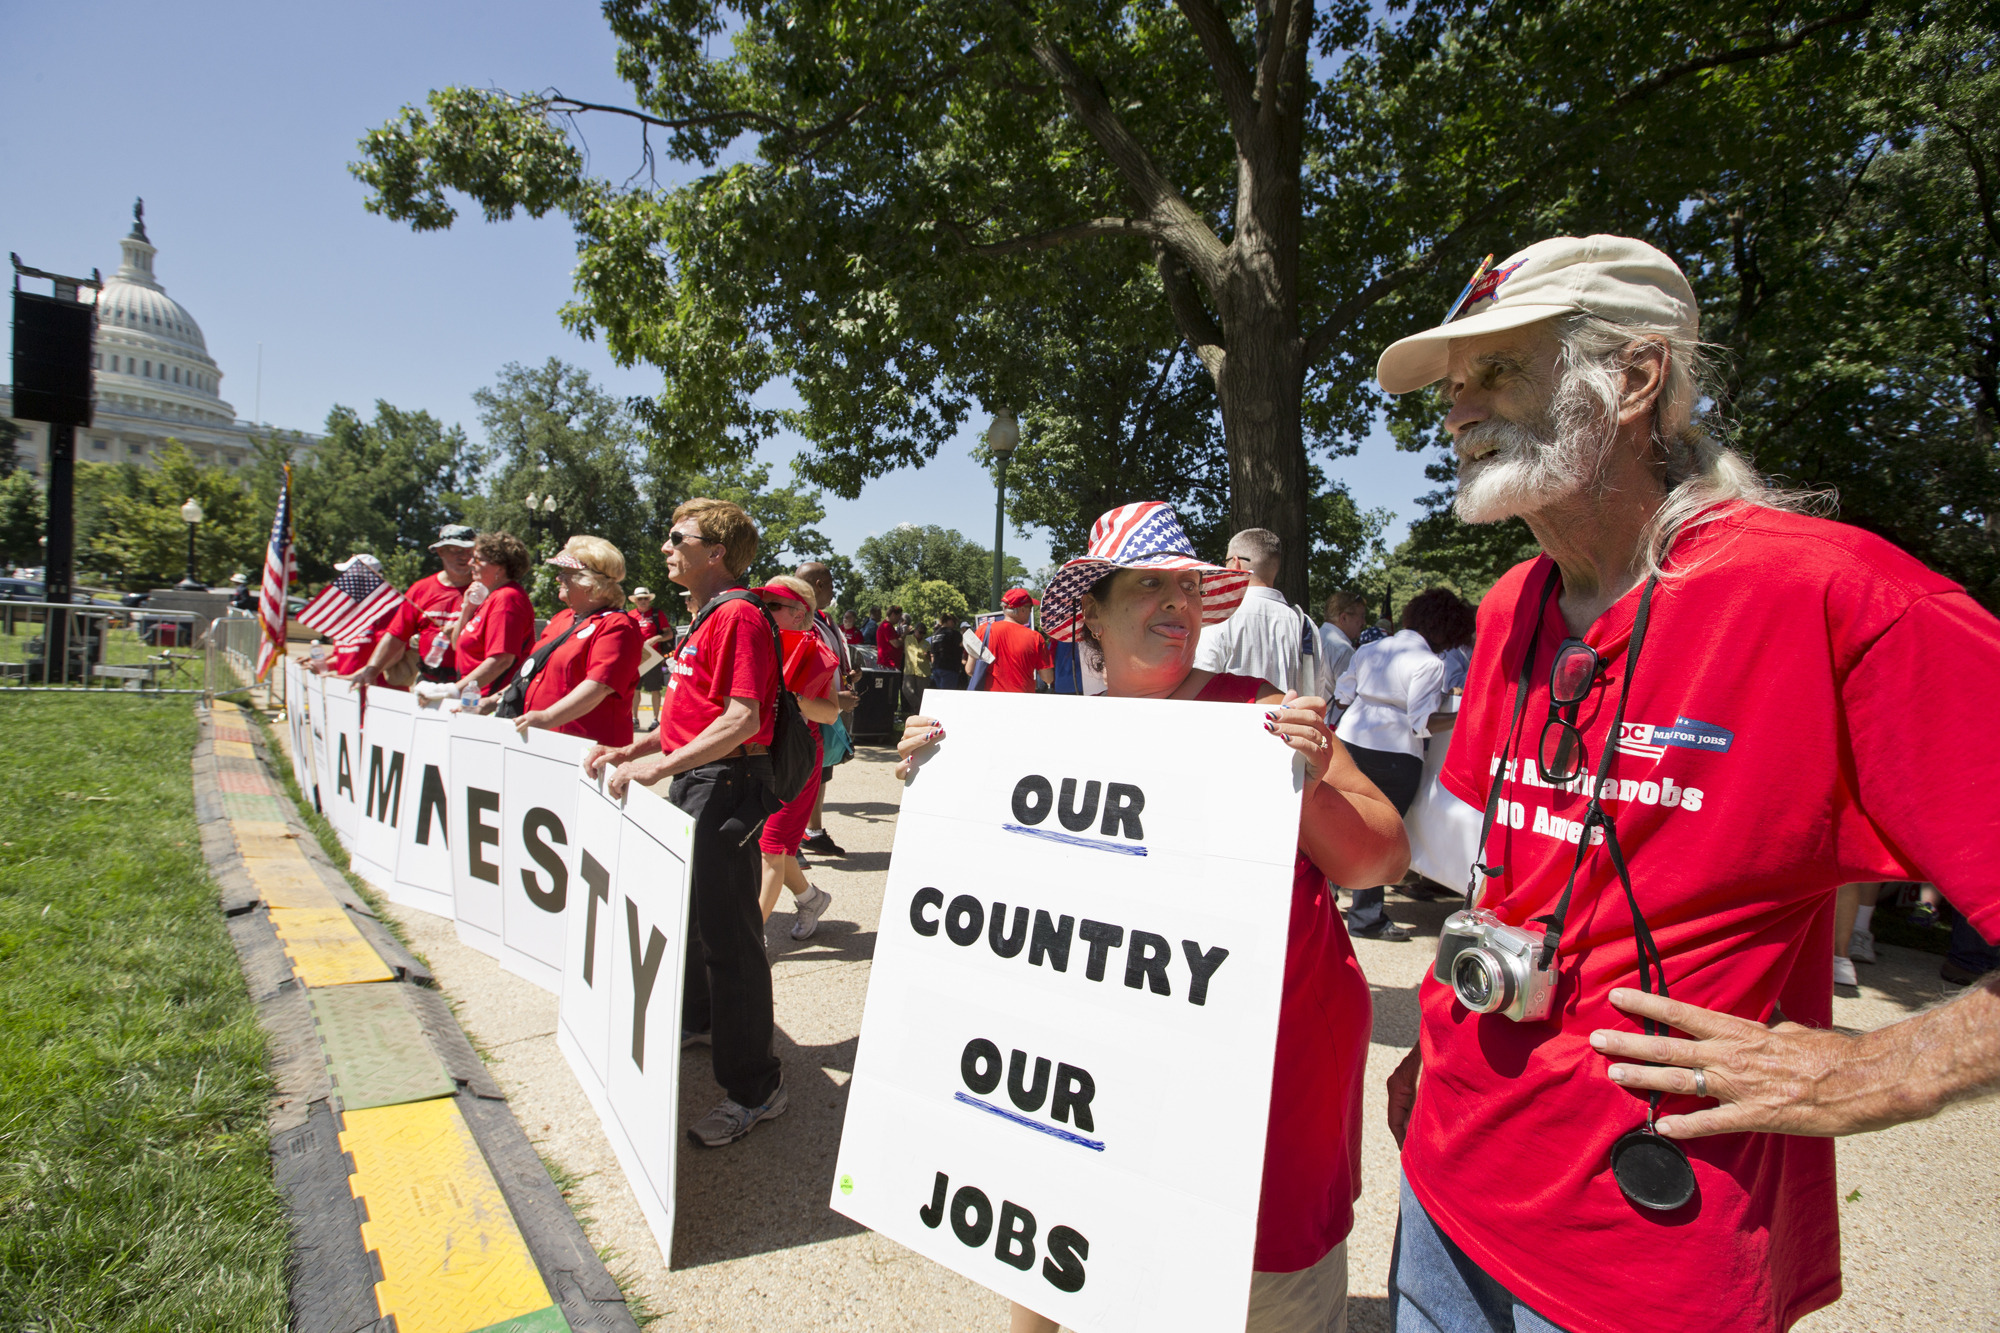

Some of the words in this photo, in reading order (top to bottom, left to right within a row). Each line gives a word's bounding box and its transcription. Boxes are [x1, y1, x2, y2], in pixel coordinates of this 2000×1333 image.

[1673, 731, 1696, 742] FOR
[1697, 735, 1727, 746] JOBS
[1011, 774, 1145, 841] OUR
[1496, 798, 1525, 830] NO
[909, 886, 1230, 1007] COUNTRY
[960, 1037, 1096, 1133] OUR
[919, 1171, 1090, 1293] JOBS
